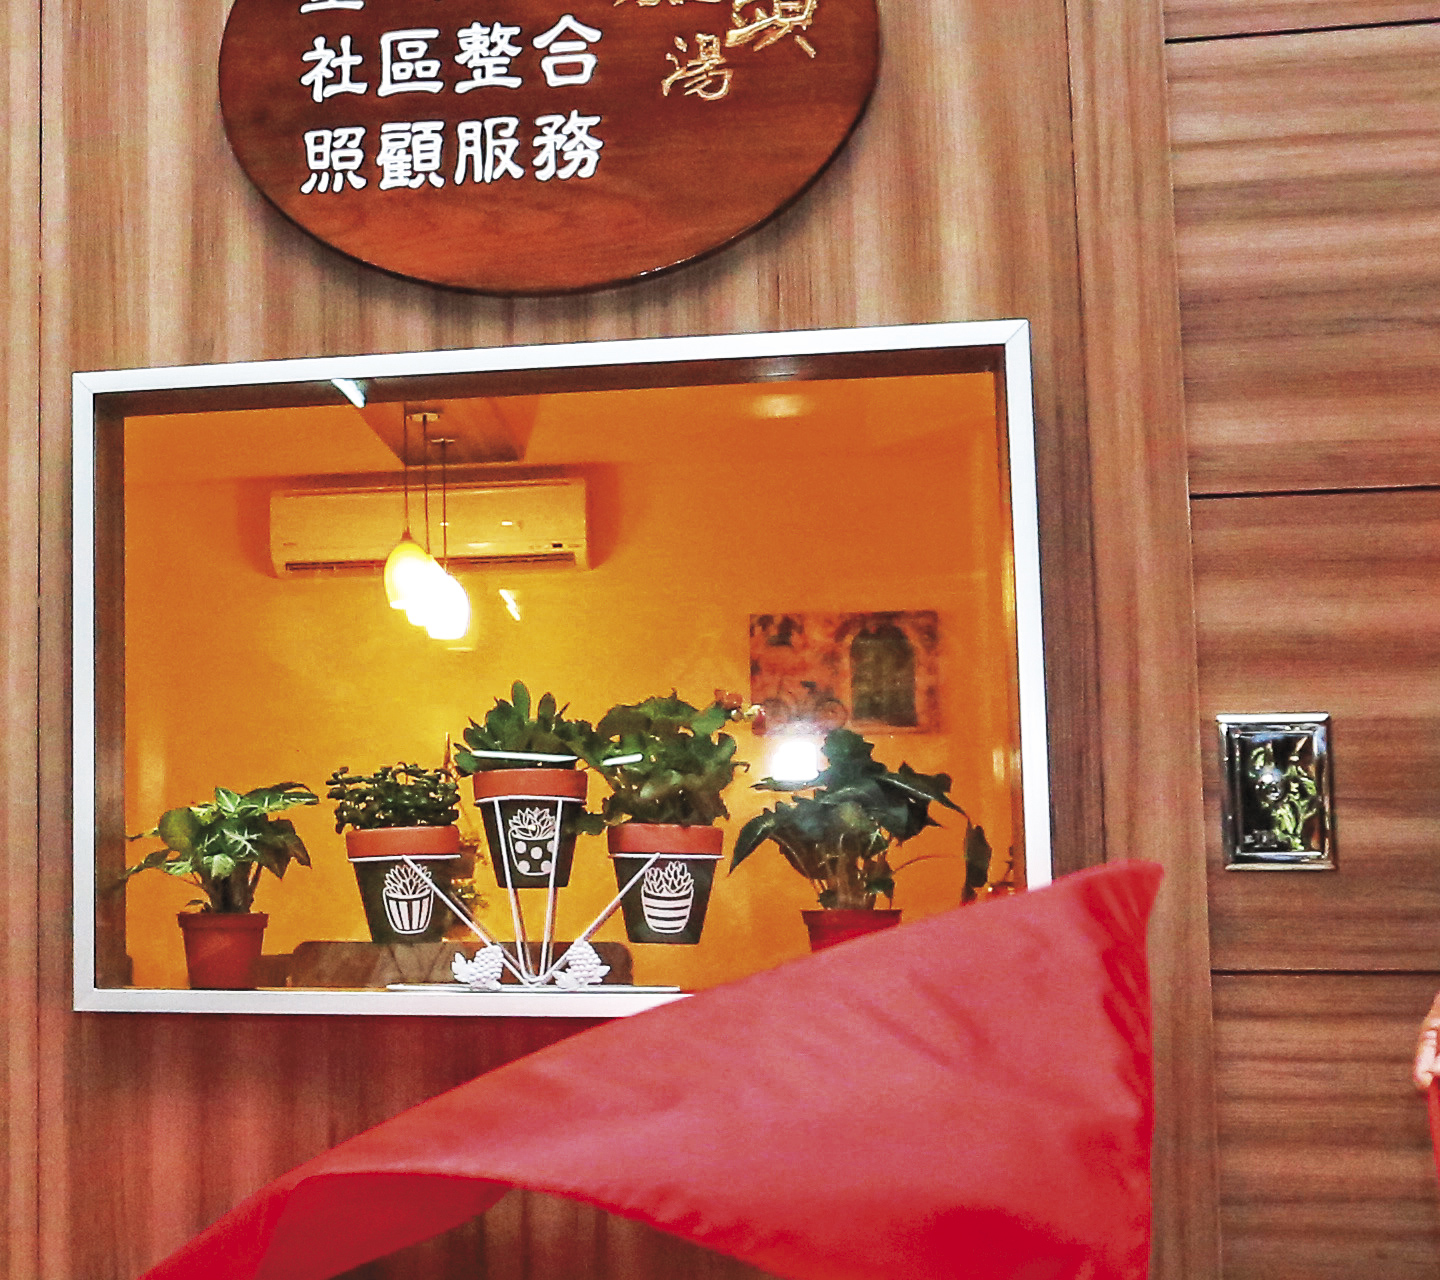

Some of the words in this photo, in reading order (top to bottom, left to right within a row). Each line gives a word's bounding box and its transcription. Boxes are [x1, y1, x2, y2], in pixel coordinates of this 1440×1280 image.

[300, 14, 603, 104] 社區整合
[300, 110, 605, 194] 照顧服務
